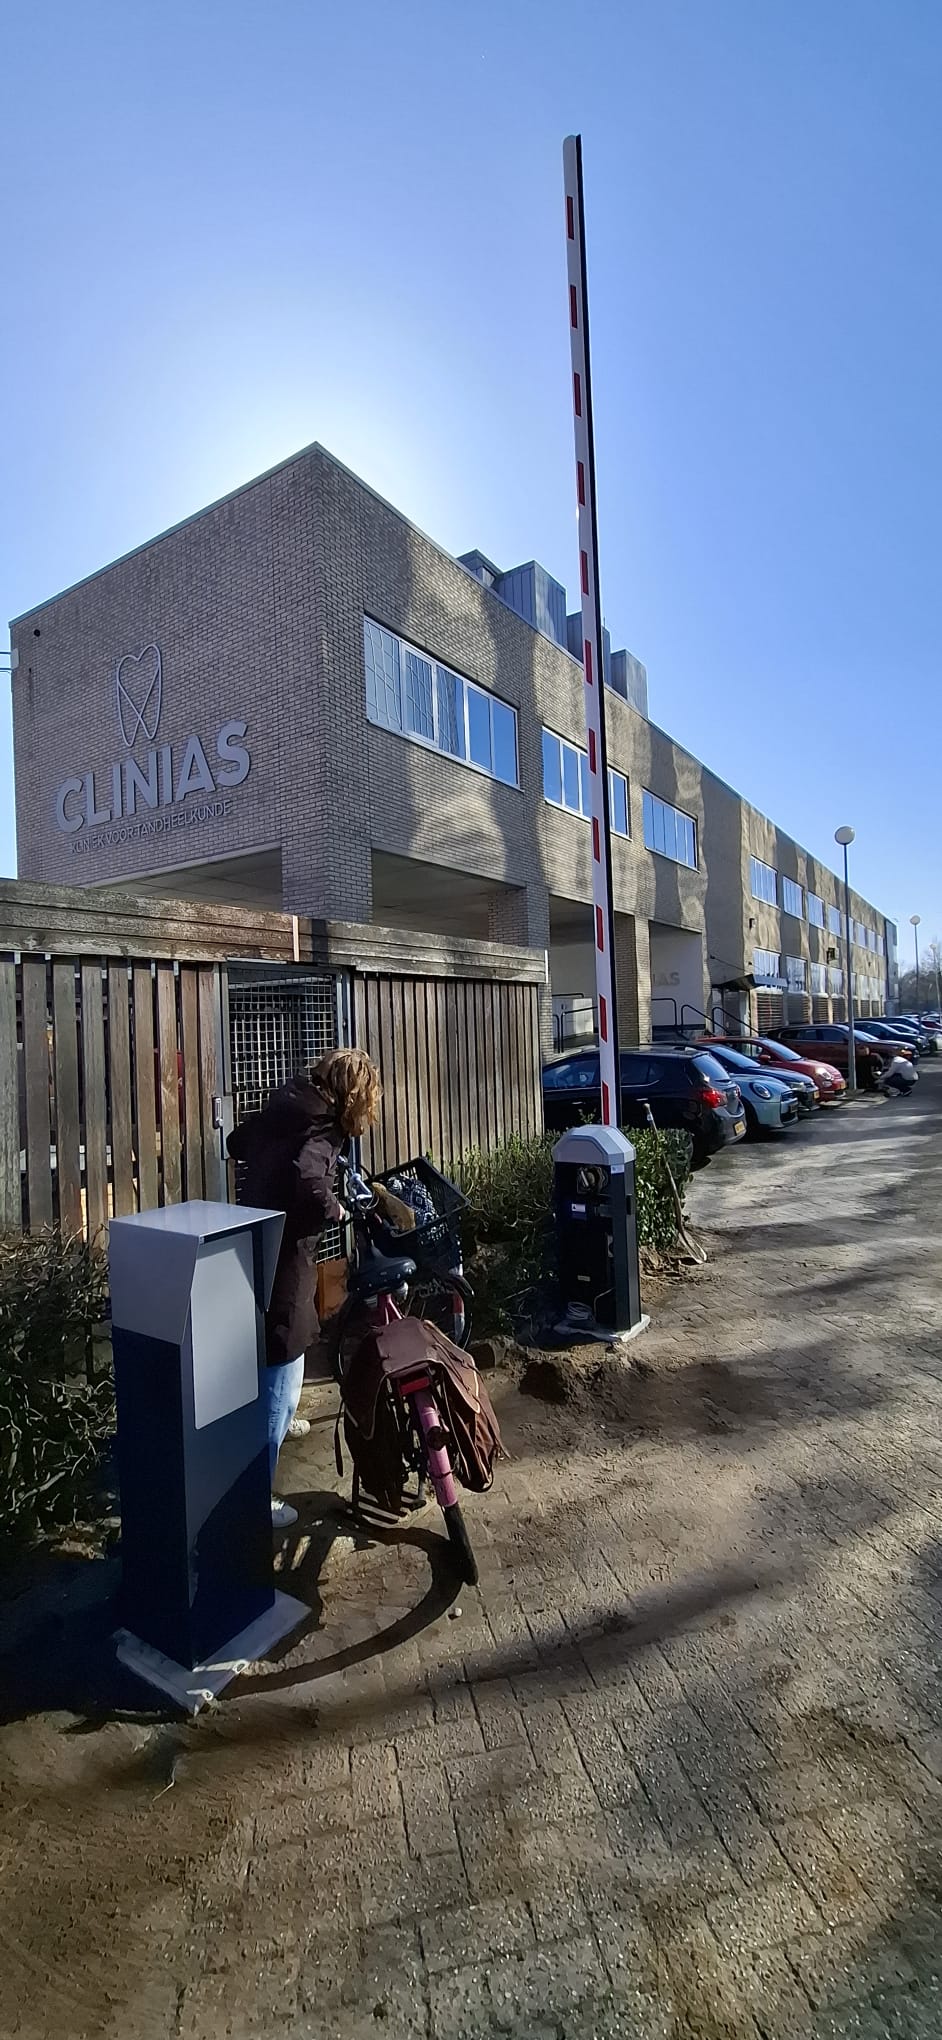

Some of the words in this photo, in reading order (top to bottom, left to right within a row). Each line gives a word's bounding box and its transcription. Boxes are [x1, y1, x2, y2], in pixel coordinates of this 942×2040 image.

[56, 720, 250, 833] CLINIAS
[105, 826, 134, 844] VOOR
[135, 800, 232, 838] TANDHEELKUNDE
